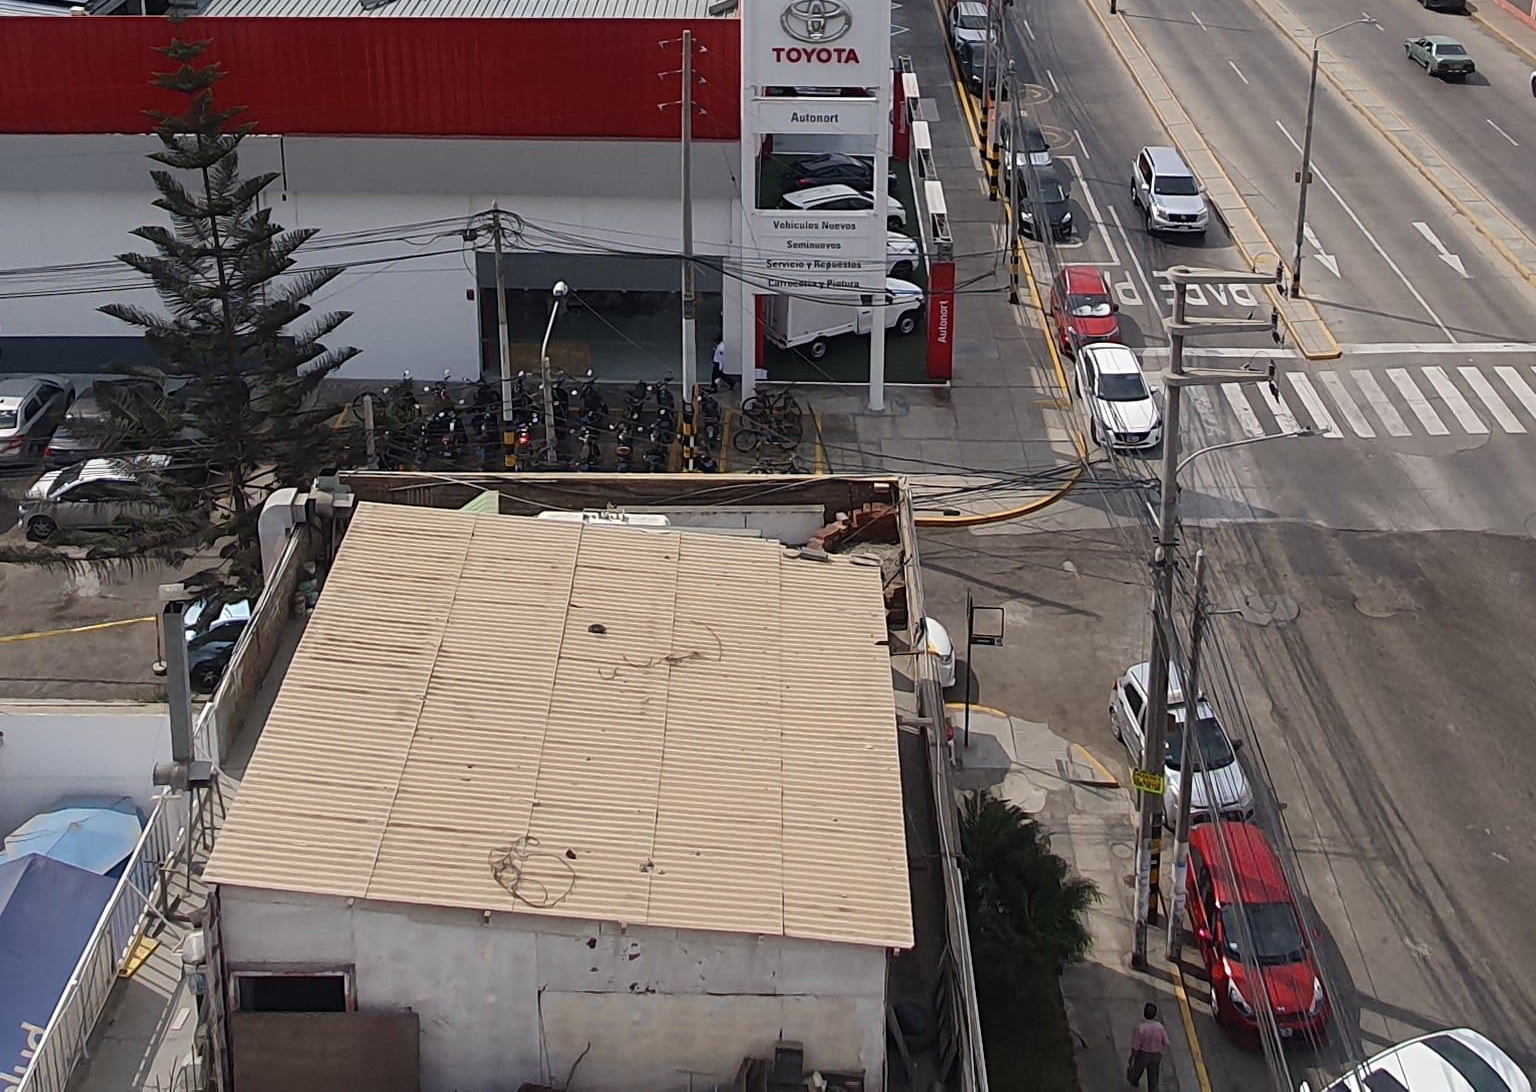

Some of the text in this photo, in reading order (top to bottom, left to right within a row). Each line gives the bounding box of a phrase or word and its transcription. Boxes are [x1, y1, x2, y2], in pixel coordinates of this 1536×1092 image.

[772, 47, 860, 64] TOYOTA
[790, 112, 839, 123] Autonort
[821, 220, 856, 230] Nuevos
[786, 239, 842, 249] Seminuevos
[766, 259, 862, 270] Servicio y Repuestos
[937, 299, 949, 344] Autonort
